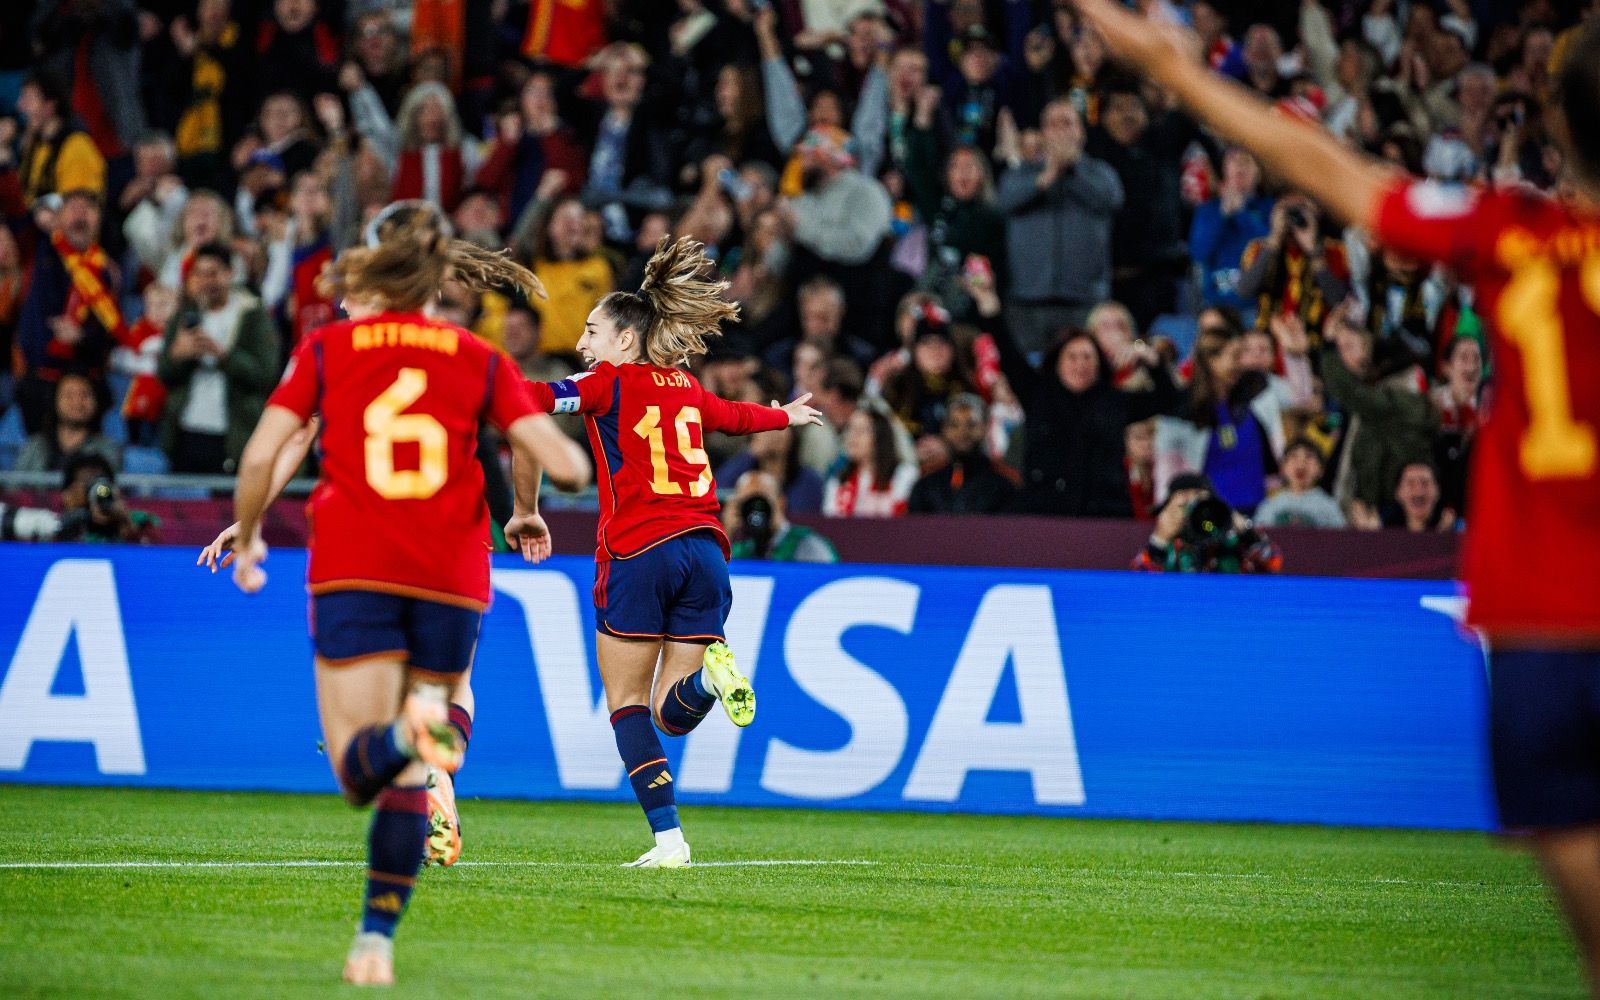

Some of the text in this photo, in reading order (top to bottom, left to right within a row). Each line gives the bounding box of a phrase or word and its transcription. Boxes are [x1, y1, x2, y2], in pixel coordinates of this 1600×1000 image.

[651, 370, 692, 388] OLGA
[364, 367, 448, 499] 6
[632, 405, 713, 497] 19
